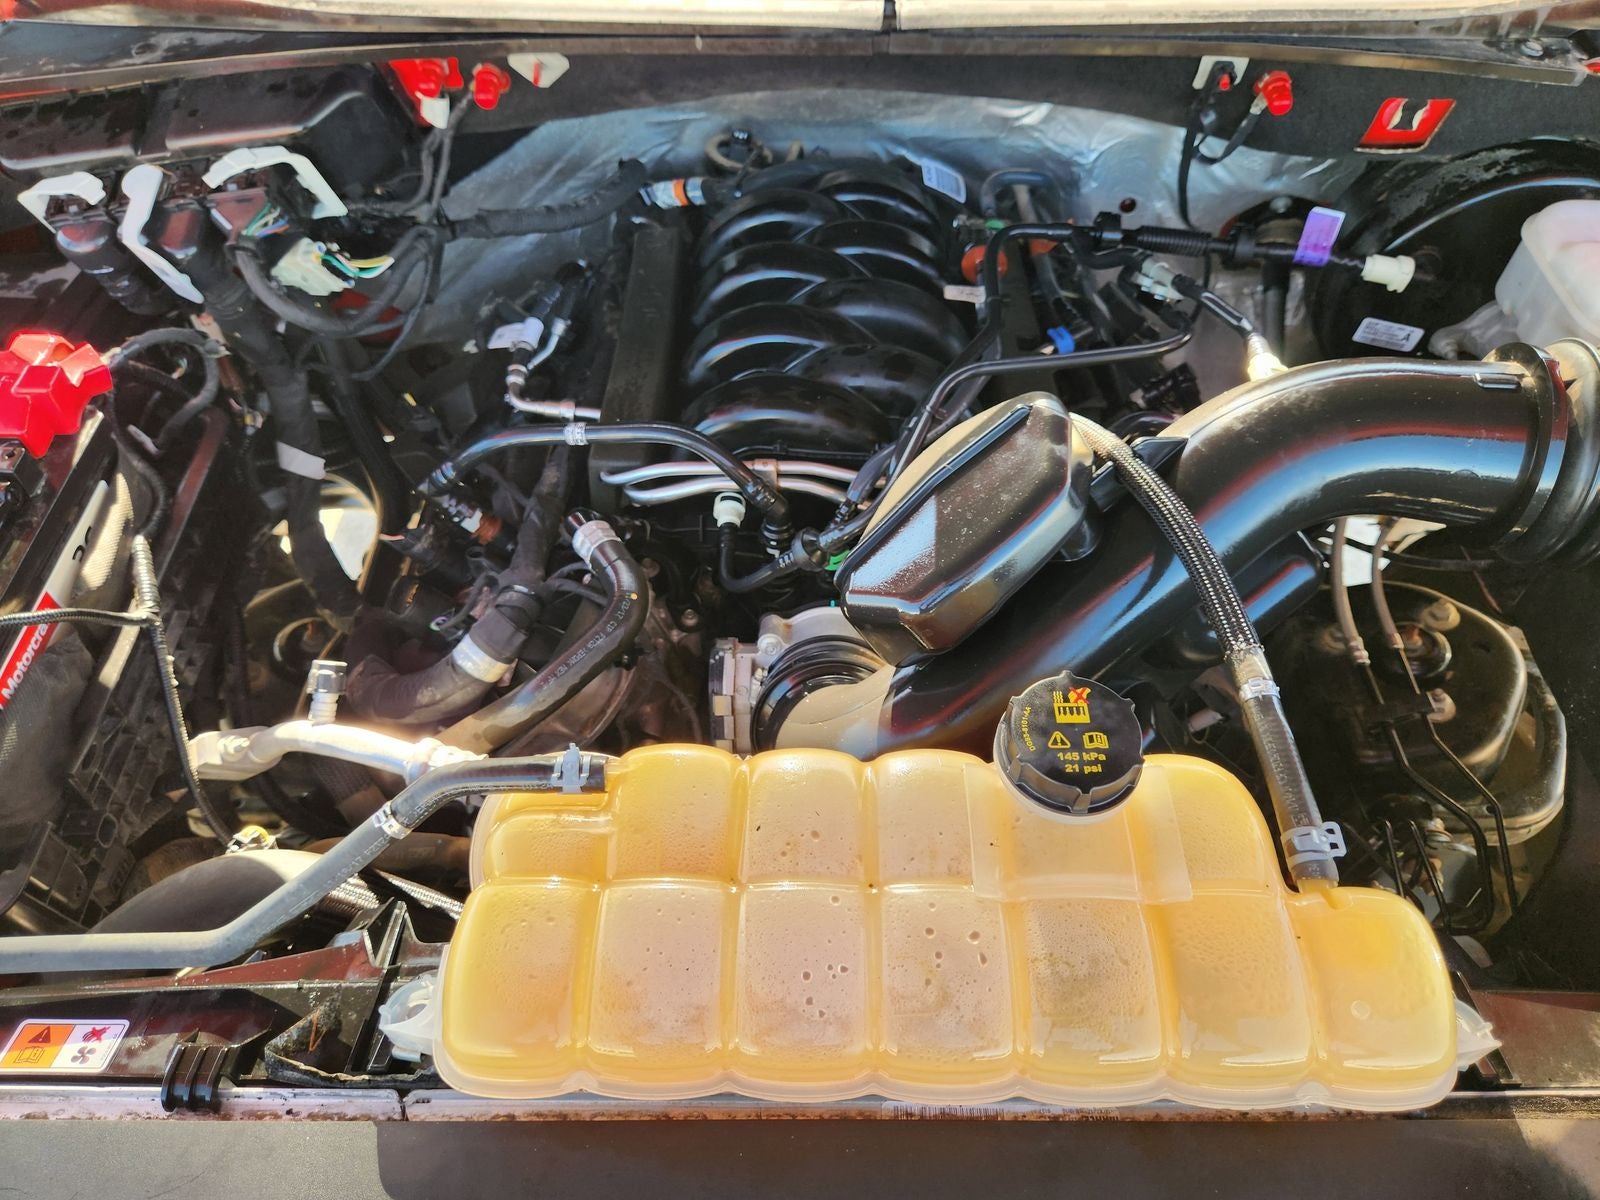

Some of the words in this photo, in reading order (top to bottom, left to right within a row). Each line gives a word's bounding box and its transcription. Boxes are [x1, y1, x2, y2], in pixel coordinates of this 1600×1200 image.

[1, 607, 51, 699] Motorcra
[1057, 751, 1080, 761] 145
[1083, 751, 1106, 761] kPa
[1065, 764, 1079, 773] 21
[1083, 764, 1102, 774] psi
